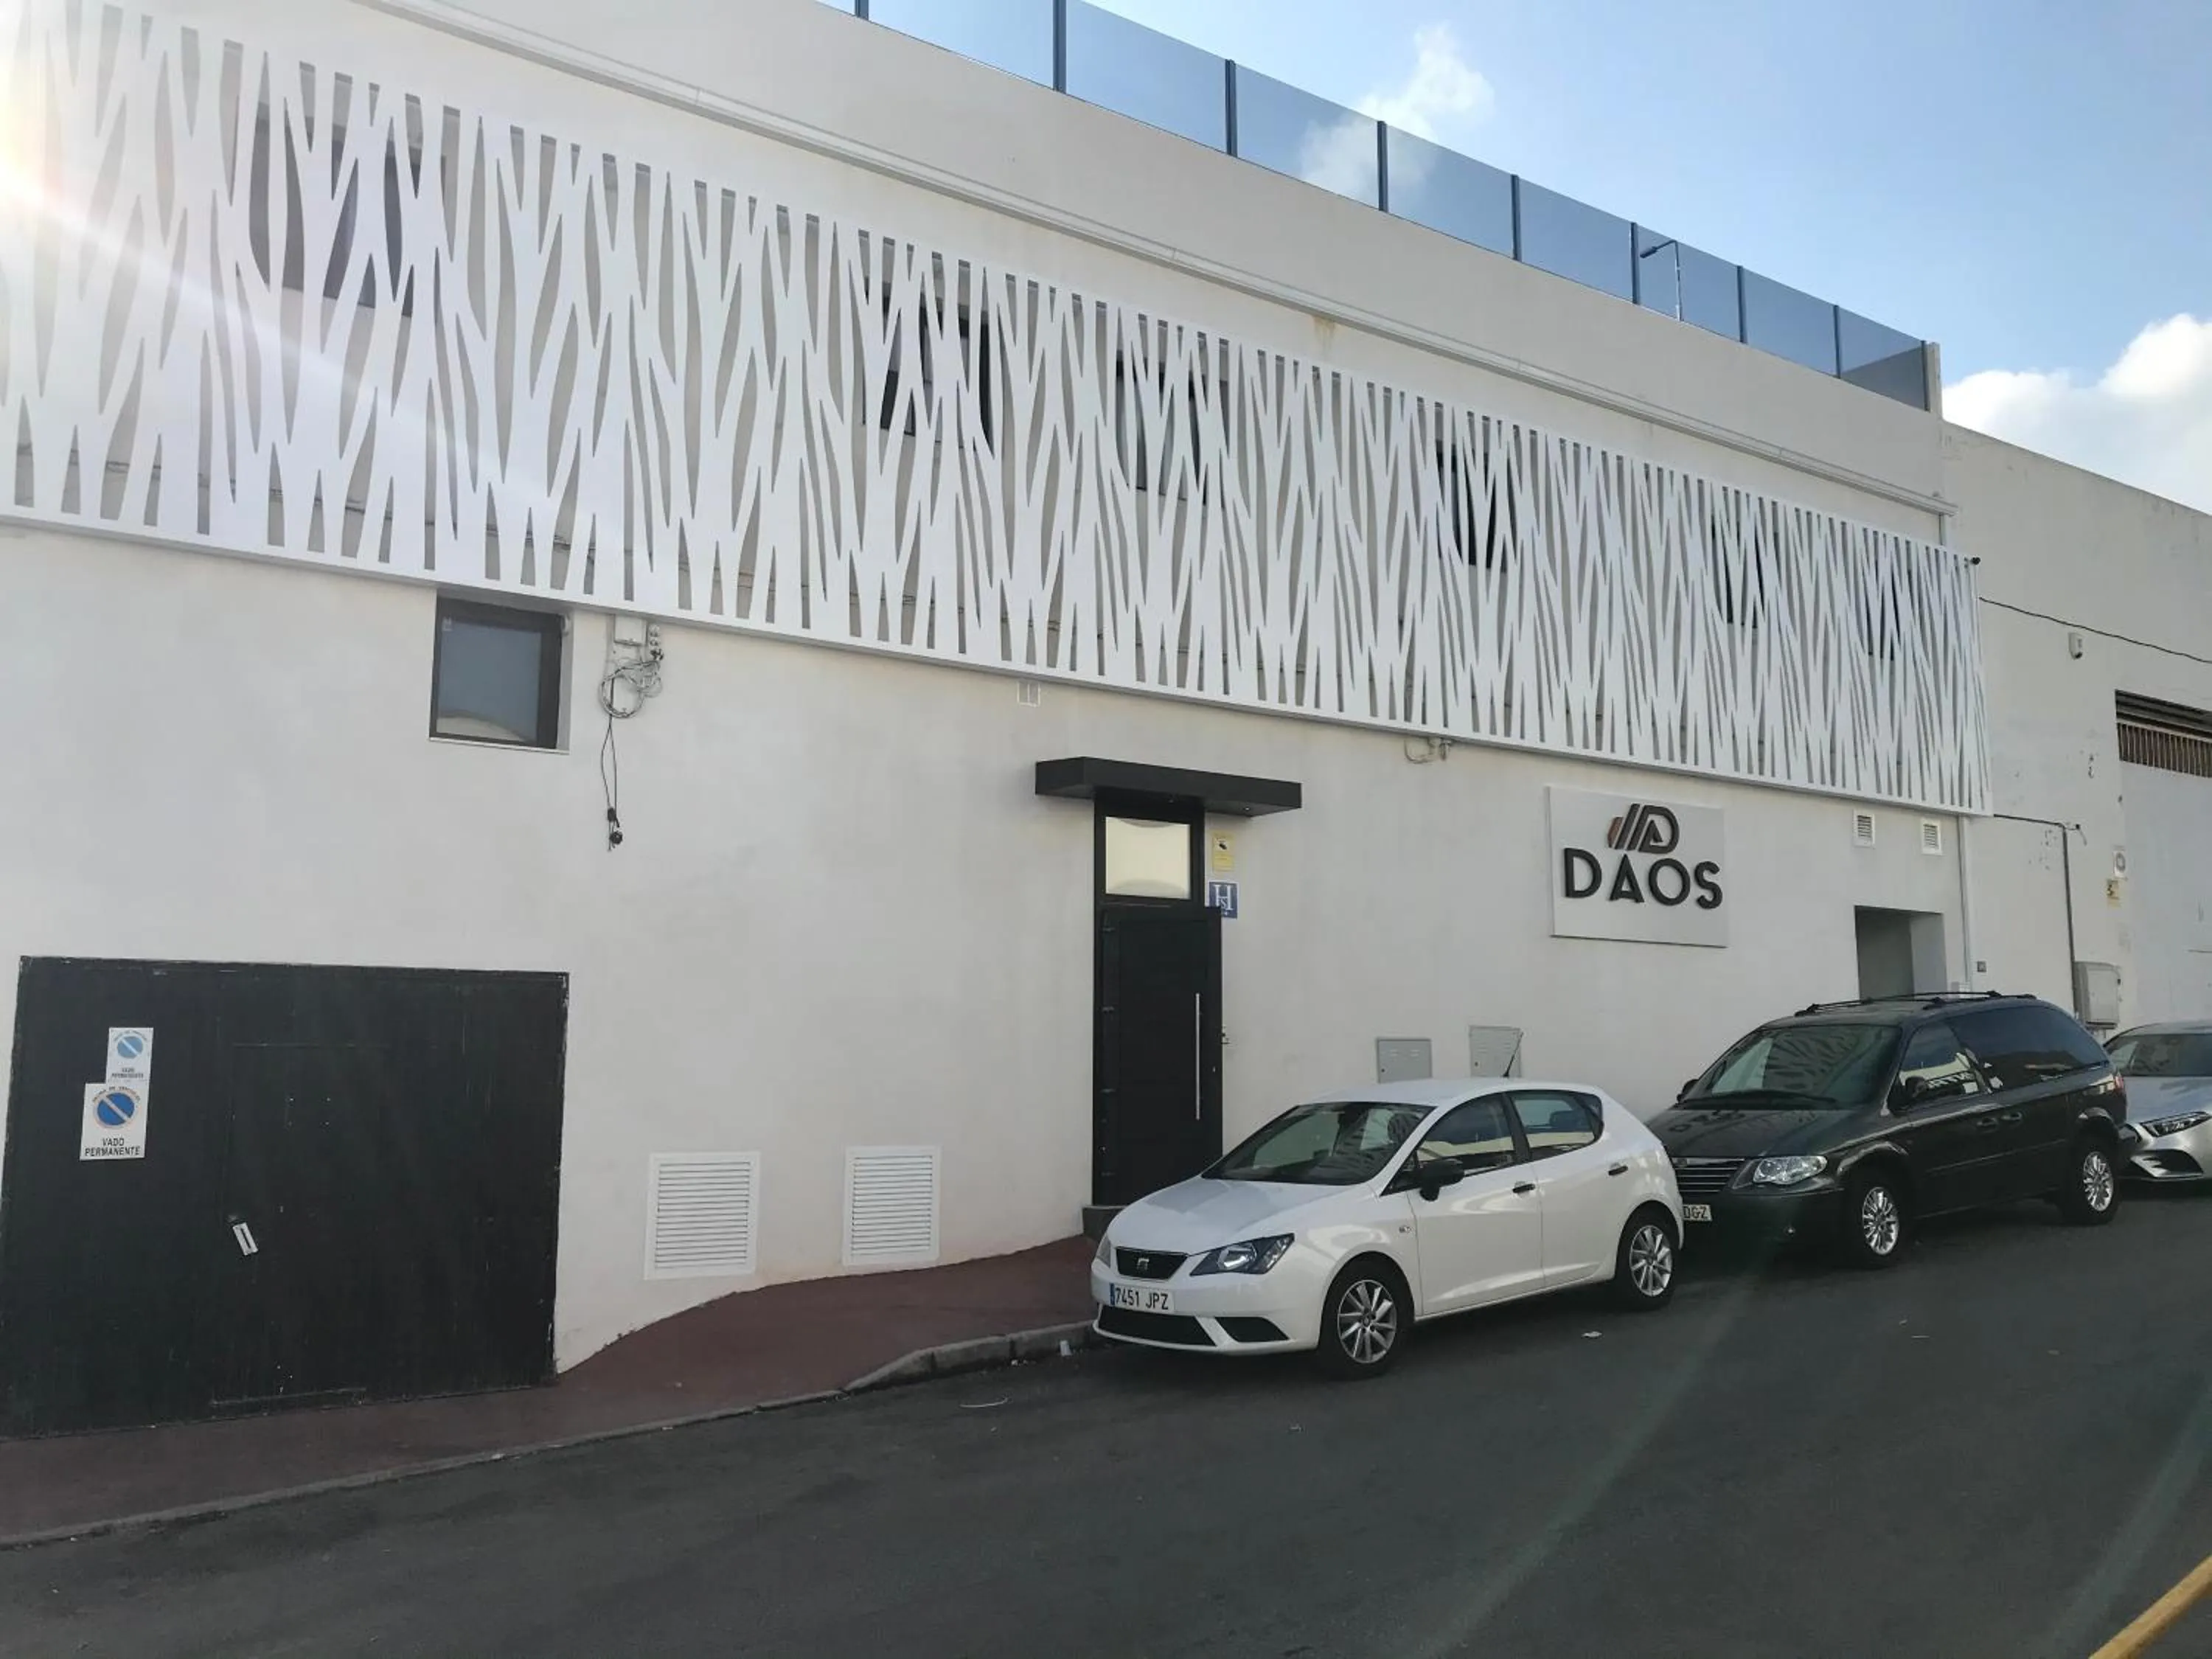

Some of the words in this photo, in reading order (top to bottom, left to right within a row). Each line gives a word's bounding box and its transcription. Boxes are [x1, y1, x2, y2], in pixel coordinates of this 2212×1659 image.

[1564, 847, 1723, 909] DAOS
[102, 1137, 125, 1147] VADO
[85, 1146, 141, 1157] PERMANENTE
[1116, 1287, 1140, 1307] 7451
[1145, 1292, 1169, 1310] JPZ
